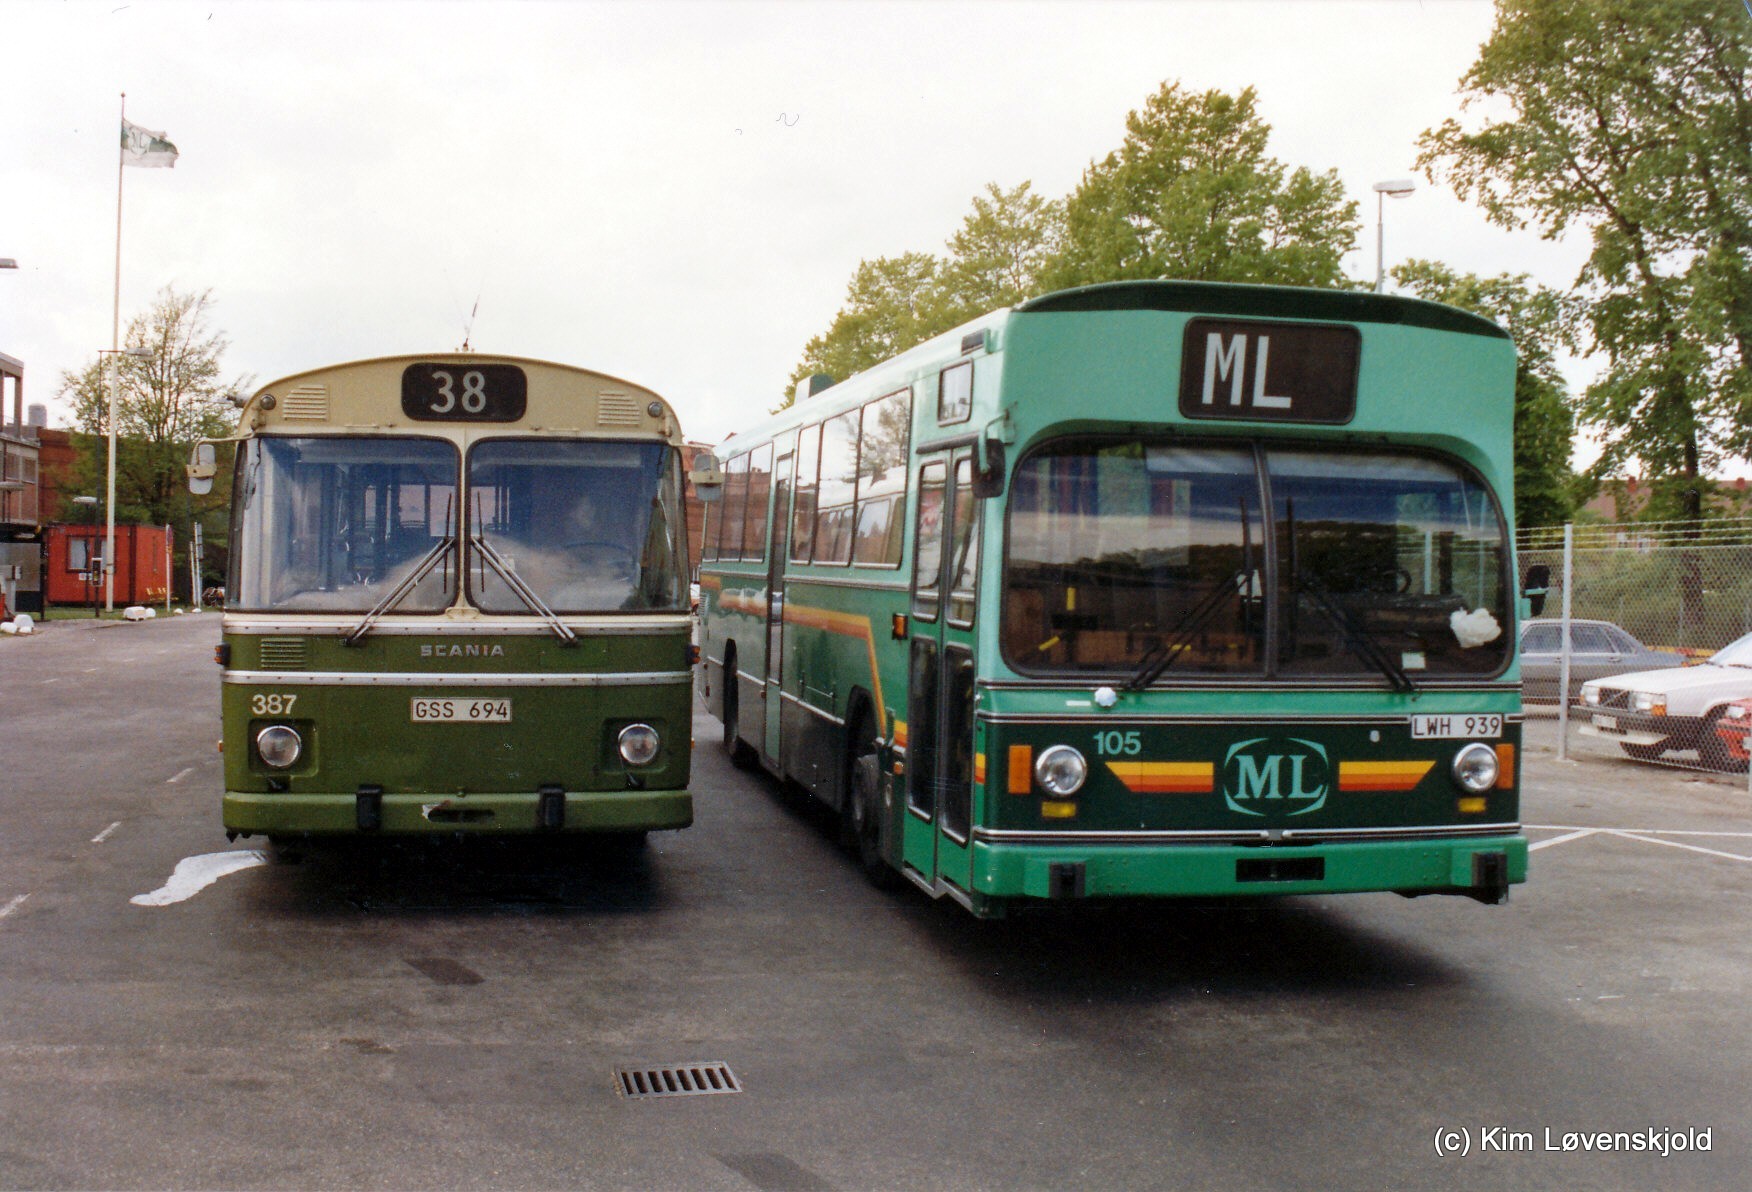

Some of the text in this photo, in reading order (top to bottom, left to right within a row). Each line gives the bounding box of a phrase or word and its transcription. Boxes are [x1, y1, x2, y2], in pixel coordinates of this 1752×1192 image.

[1202, 332, 1291, 409] ML
[430, 370, 486, 413] 38
[420, 644, 505, 657] SCANIA
[252, 694, 297, 715] 387
[415, 701, 508, 718] GSS 694
[1413, 717, 1500, 736] LWH 939
[1093, 731, 1142, 755] 105
[1233, 754, 1324, 799] ML
